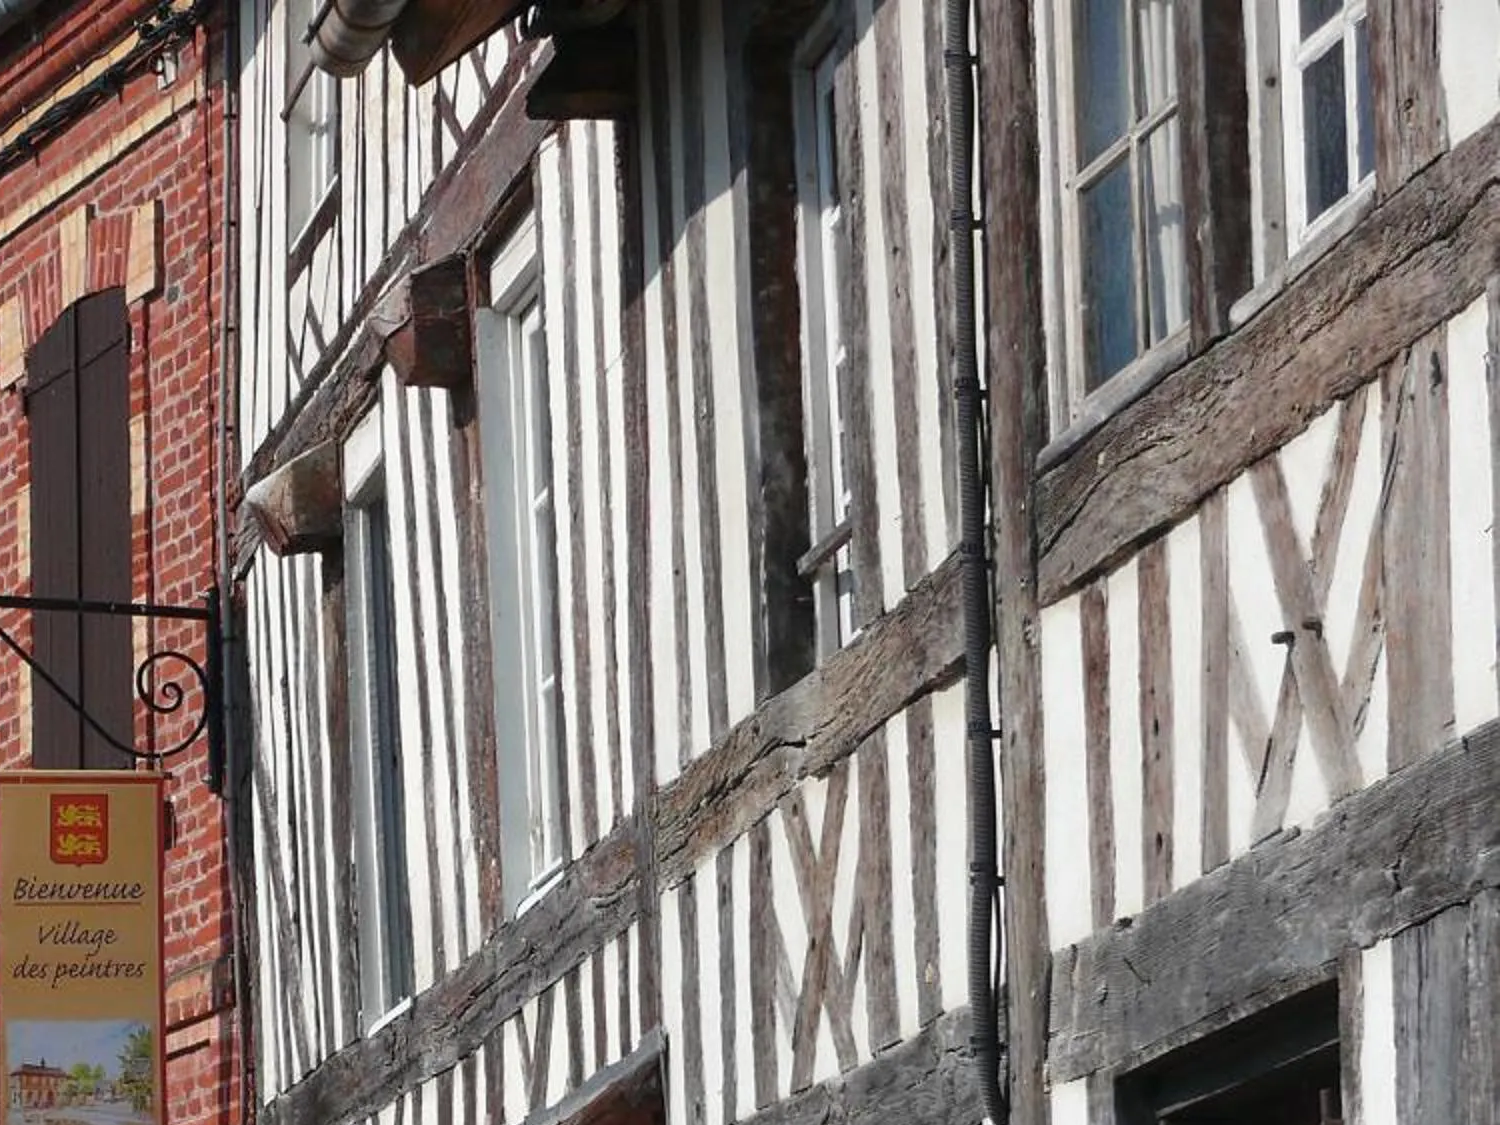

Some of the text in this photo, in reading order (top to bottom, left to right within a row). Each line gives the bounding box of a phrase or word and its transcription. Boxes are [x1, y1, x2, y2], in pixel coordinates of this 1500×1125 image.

[13, 876, 145, 900] Bienvenue
[38, 920, 118, 958] Village
[12, 954, 146, 989] des peintres
